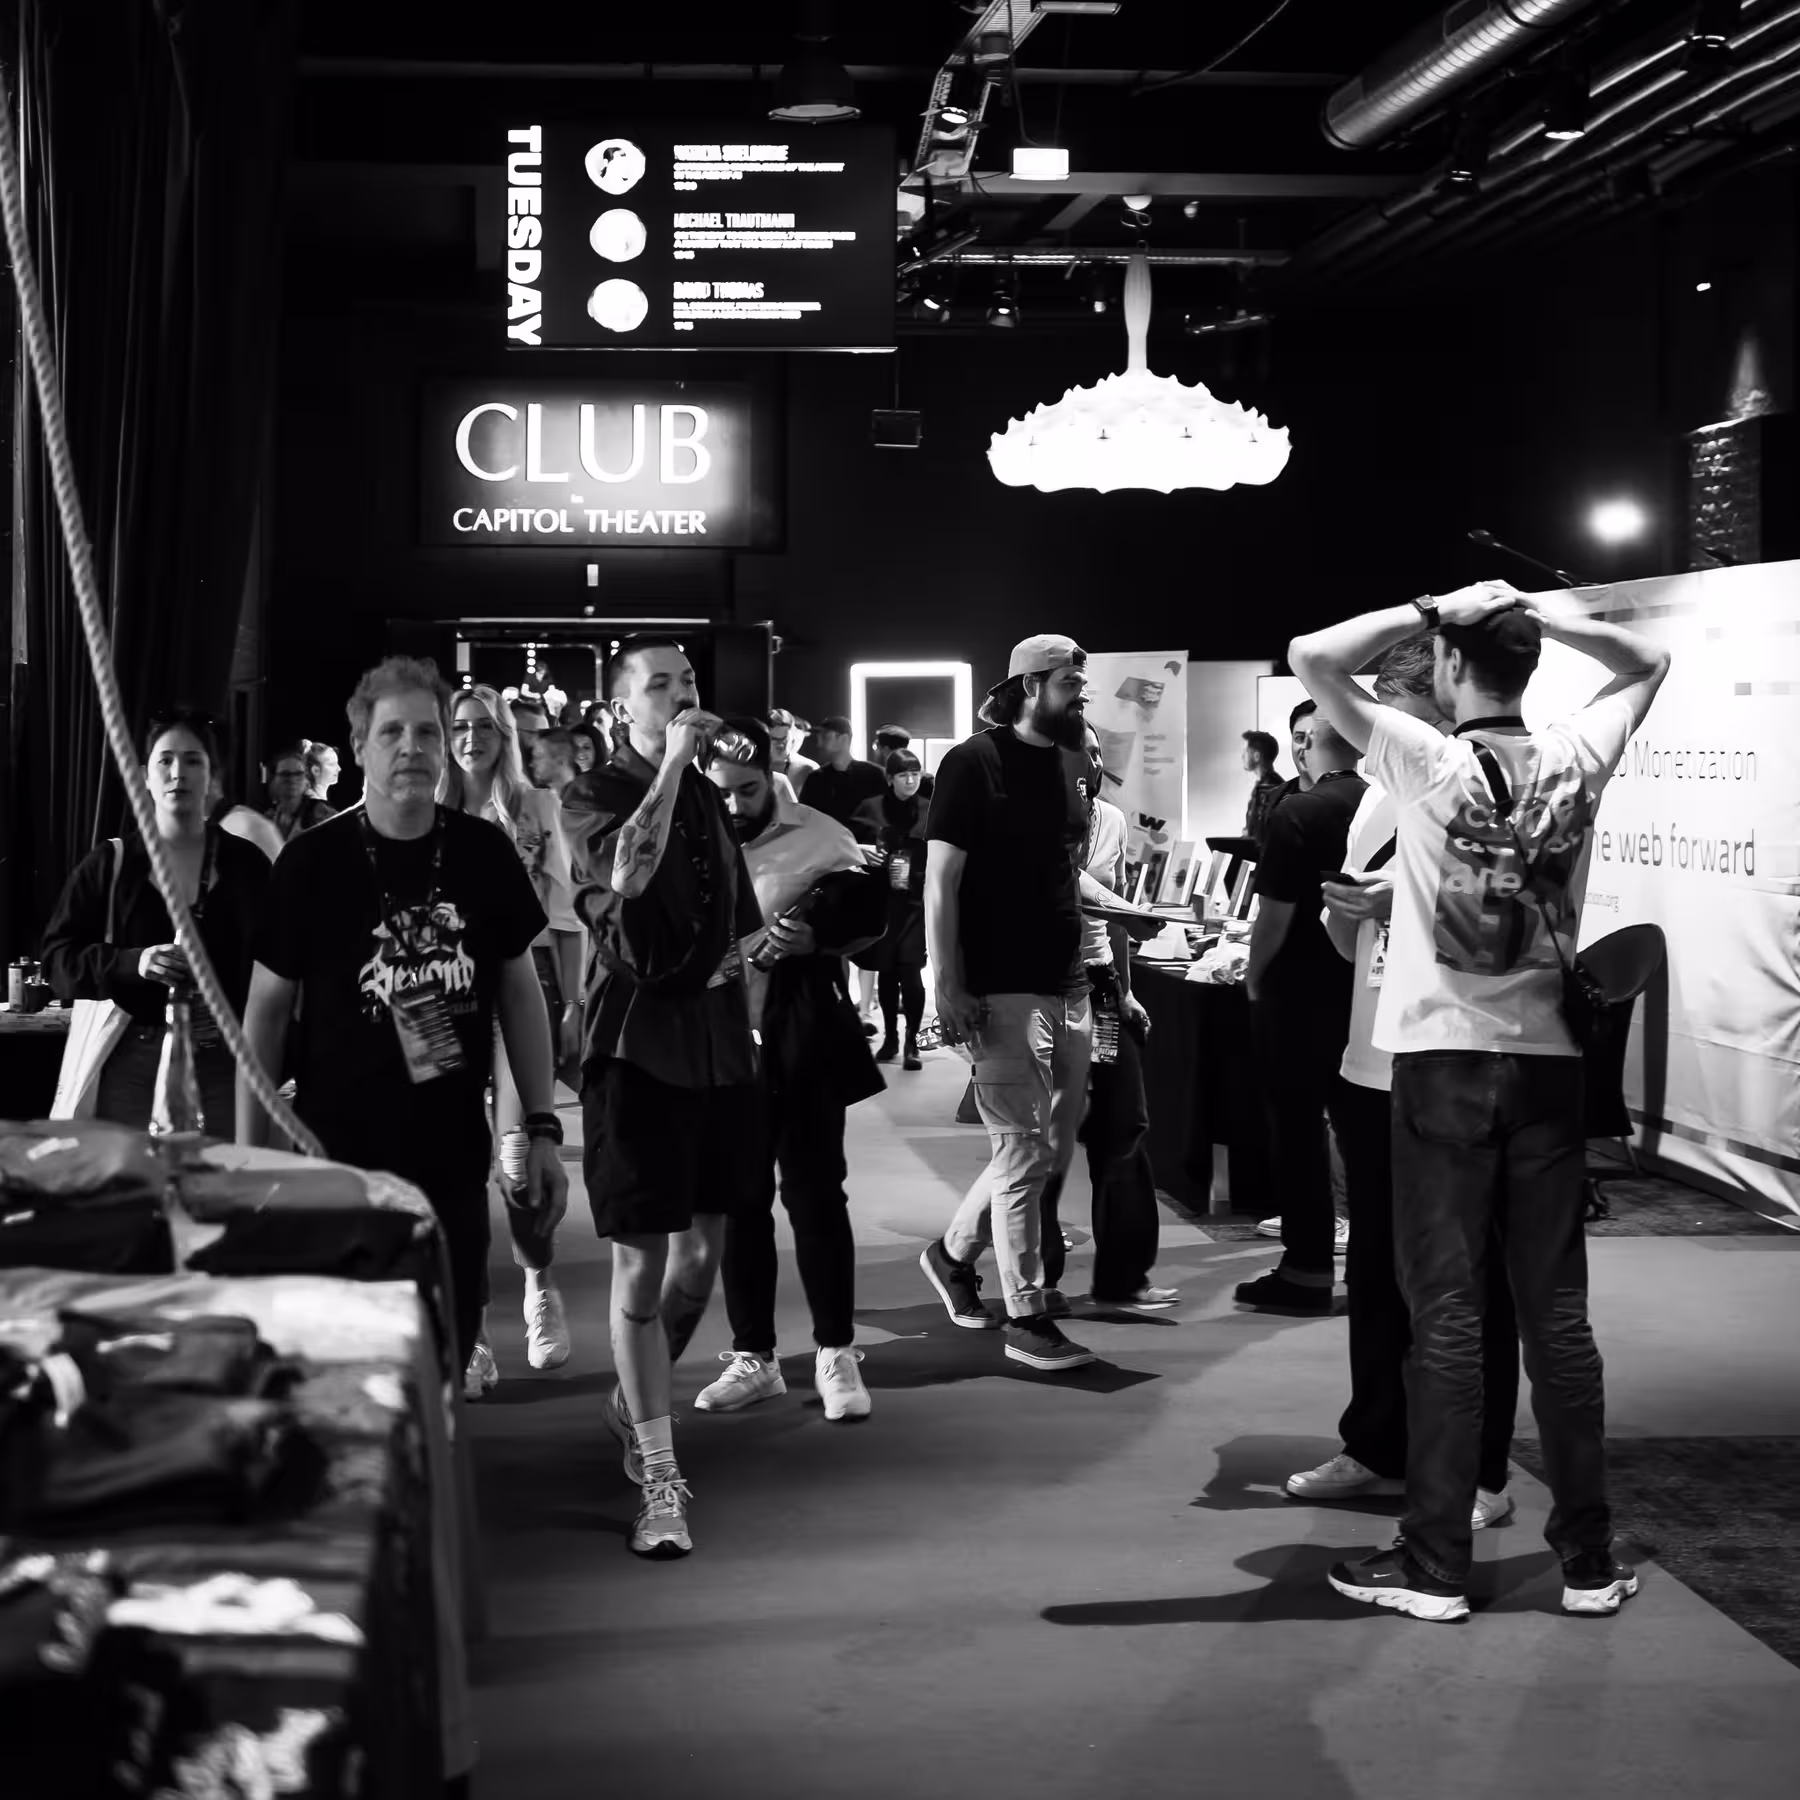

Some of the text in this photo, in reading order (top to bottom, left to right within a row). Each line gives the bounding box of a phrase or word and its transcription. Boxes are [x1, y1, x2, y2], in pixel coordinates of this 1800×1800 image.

[507, 125, 542, 346] TUESDAY
[455, 402, 712, 484] CLUB
[453, 508, 707, 535] CAPITOL THEATER
[1634, 740, 1758, 782] Monetization
[1618, 821, 1664, 867] web
[1669, 822, 1756, 877] forward
[1446, 865, 1523, 898] are
